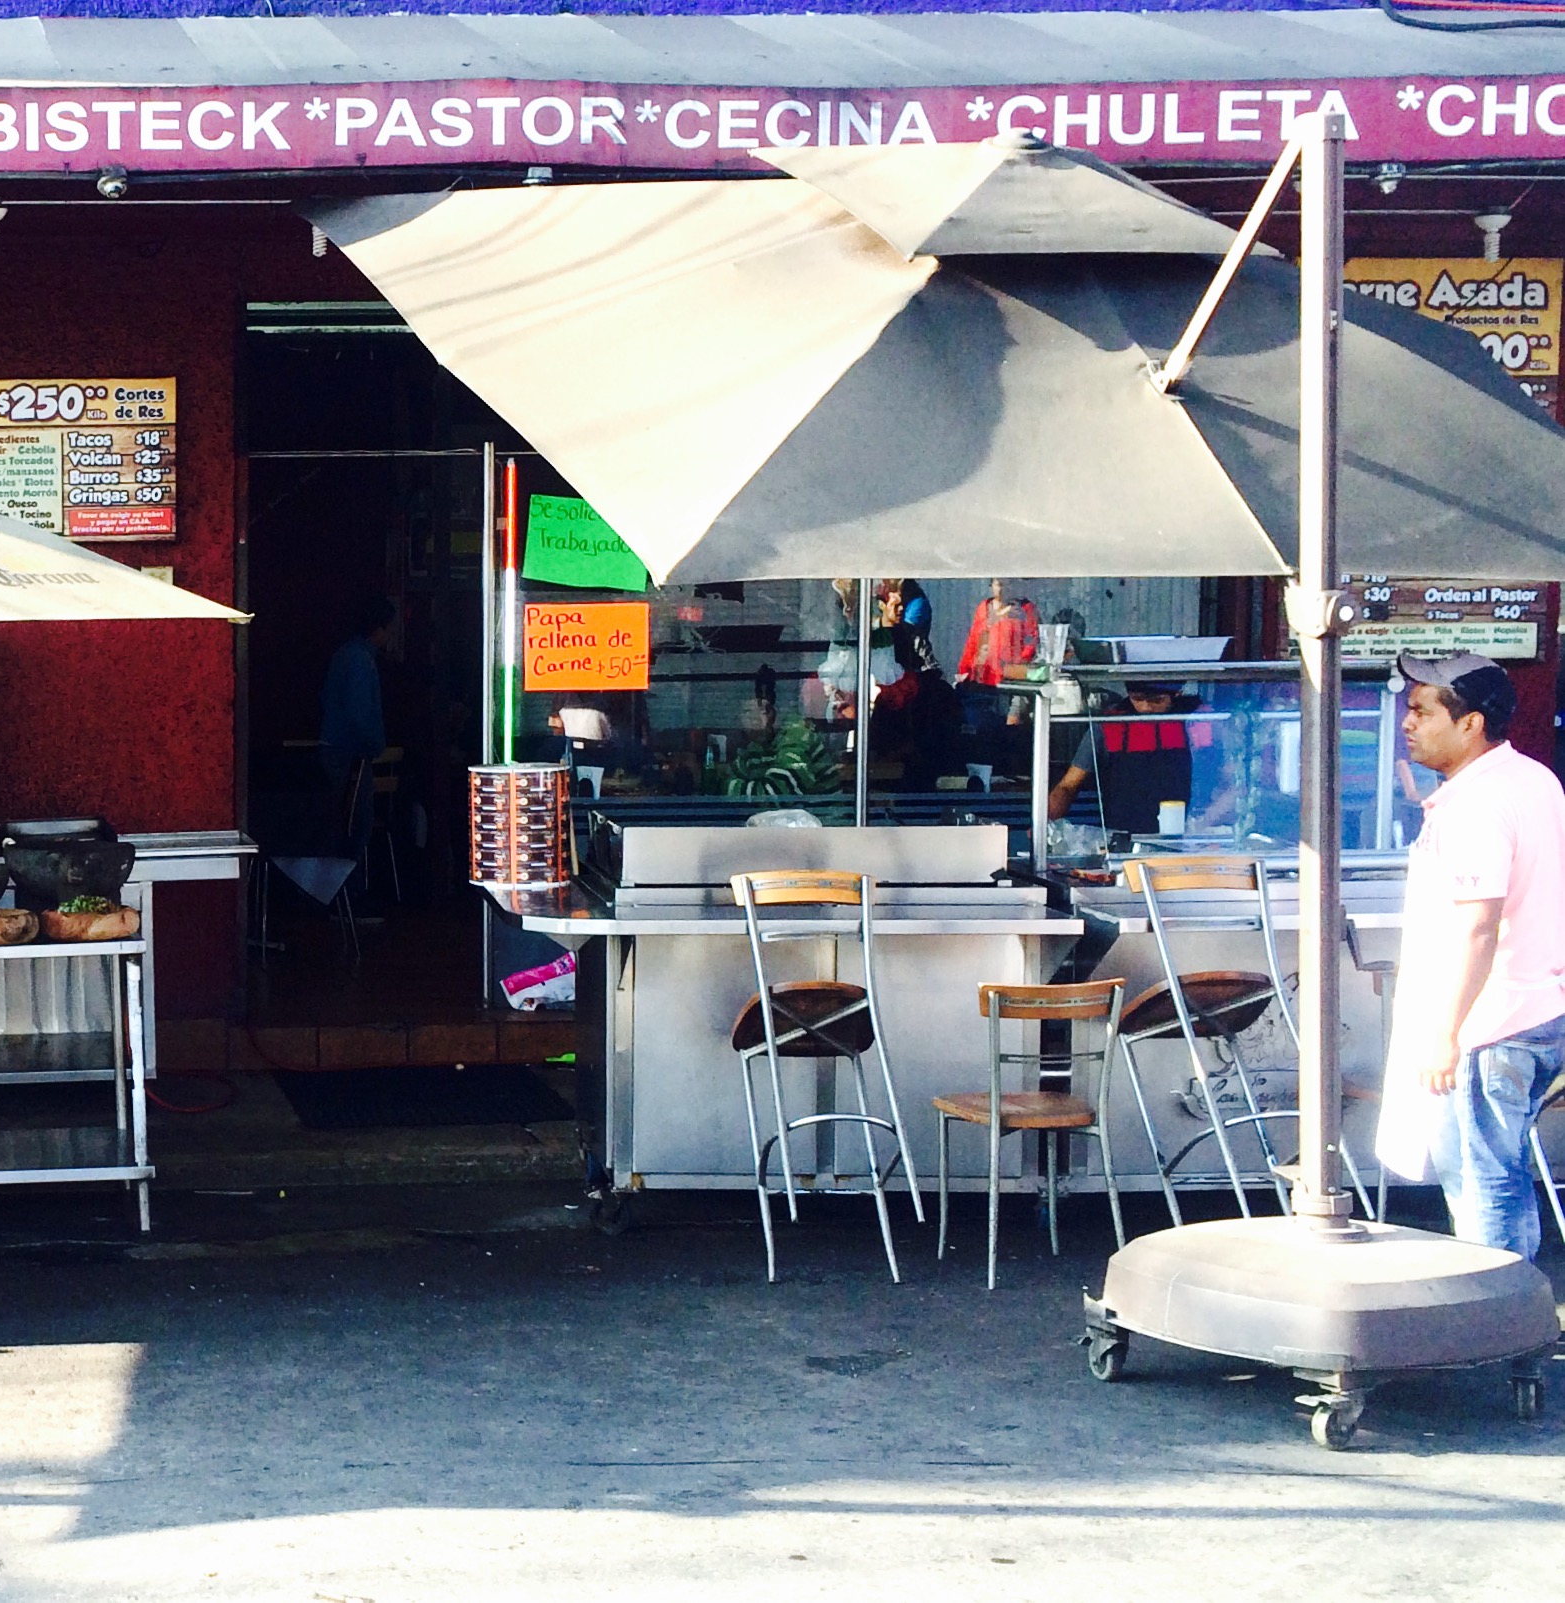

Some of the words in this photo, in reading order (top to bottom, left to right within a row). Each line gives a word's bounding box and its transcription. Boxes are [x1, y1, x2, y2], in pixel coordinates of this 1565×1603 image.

[1427, 269, 1549, 310] Asada
[1445, 314, 1500, 325] Productos
[1503, 315, 1517, 324] de
[1520, 314, 1539, 324] Res
[115, 387, 166, 402] Cortes
[86, 409, 108, 420] Kilo
[115, 405, 134, 419] de
[138, 405, 164, 419] Res
[67, 431, 113, 448] Tacos
[18, 445, 56, 455] Cebolla
[67, 448, 123, 467] Volcán
[24, 477, 54, 486] Elotes
[68, 468, 120, 485] Burros
[22, 488, 58, 498] Morrón
[68, 486, 130, 507] Gringas
[7, 500, 38, 509] Queso
[531, 495, 552, 519] Se
[19, 510, 52, 519] Tocino
[1424, 587, 1471, 603] Orden
[1472, 587, 1487, 602] al
[1490, 587, 1538, 602] Pastor
[527, 607, 586, 631] Papa
[528, 631, 598, 649] rellena
[608, 629, 634, 648] de
[533, 655, 593, 676] Carne
